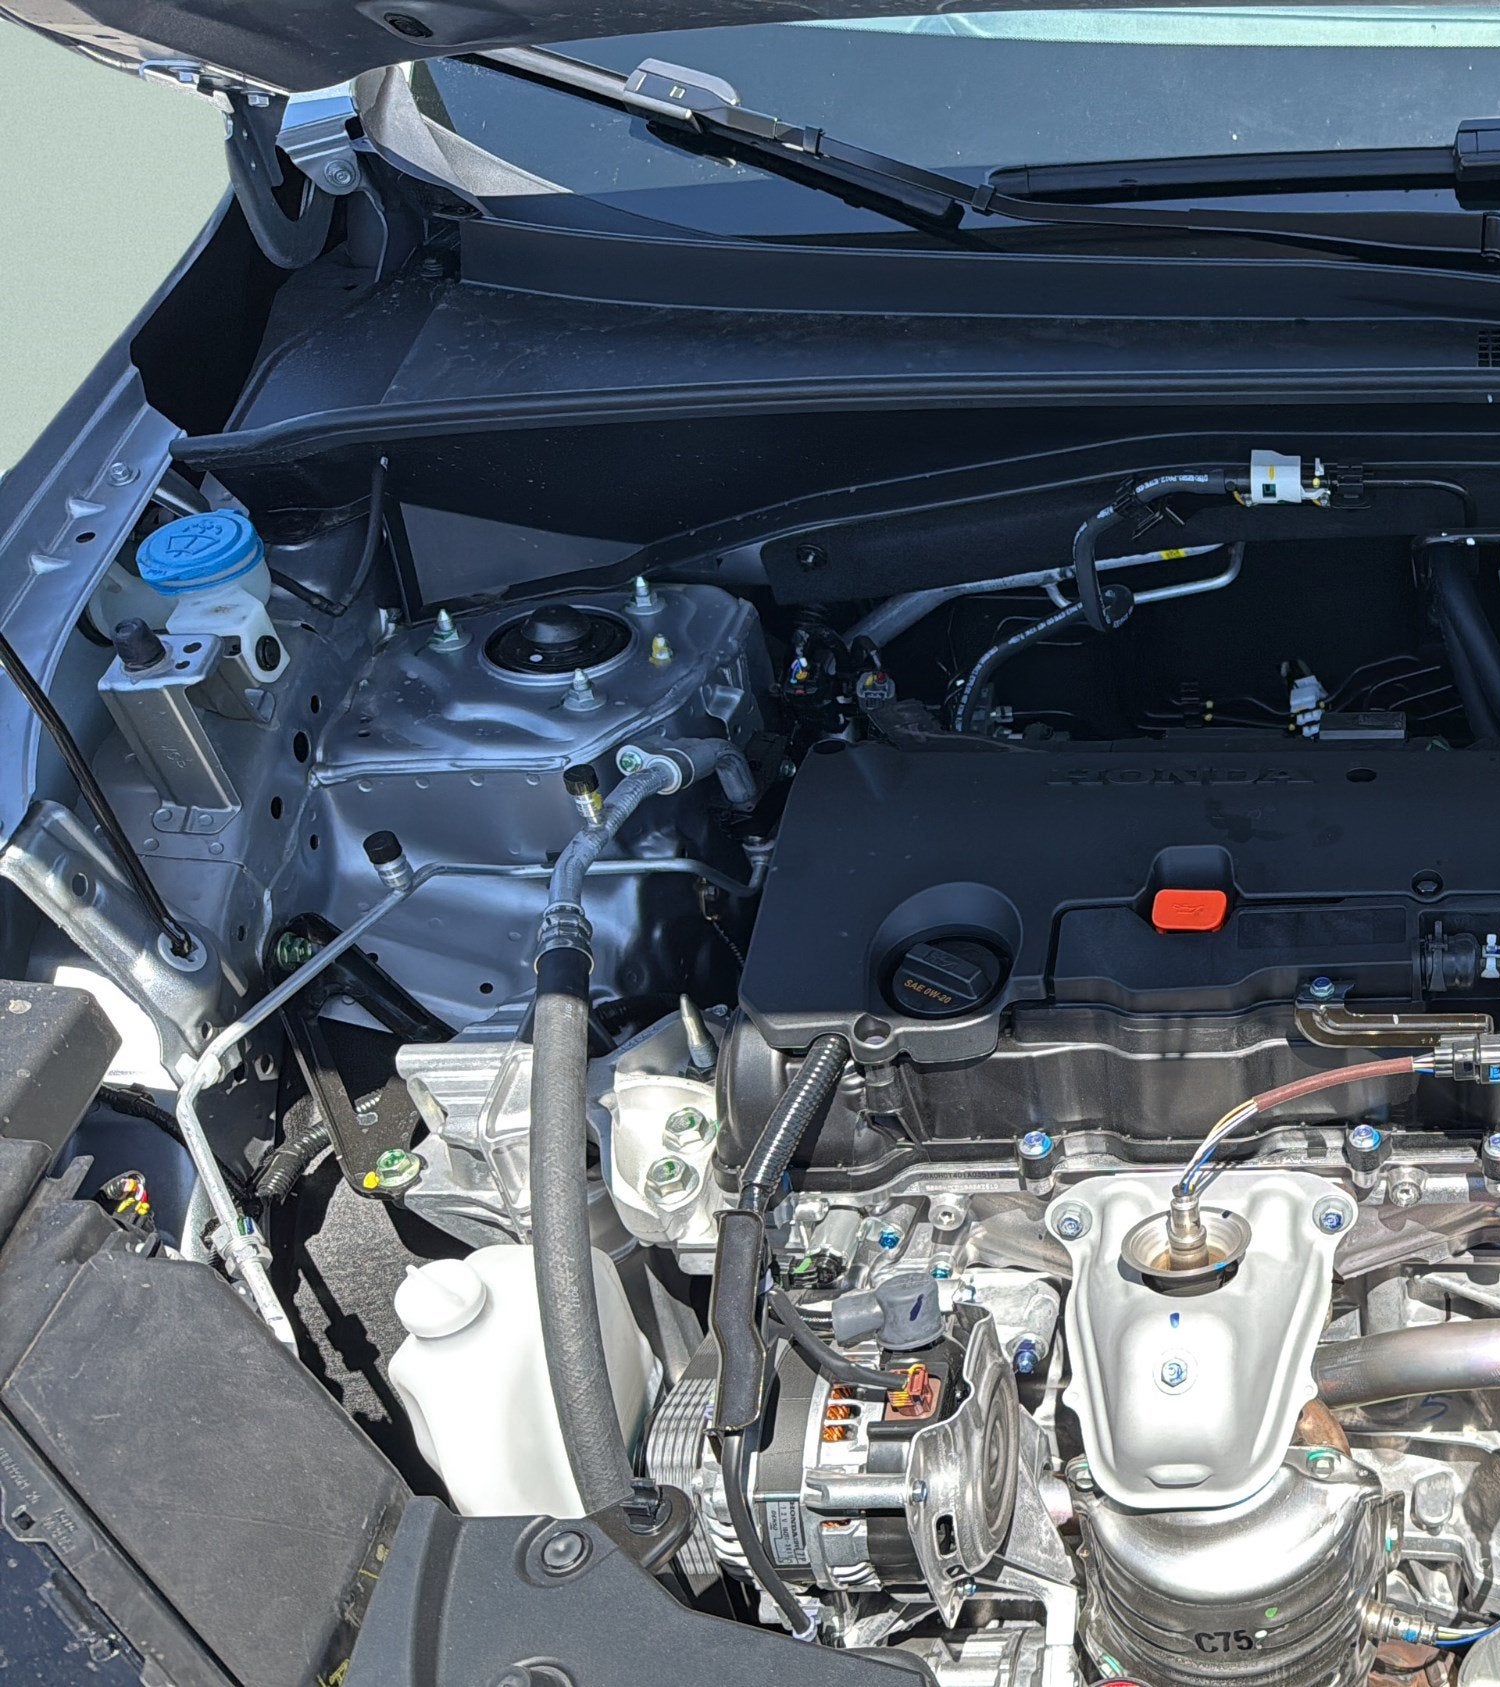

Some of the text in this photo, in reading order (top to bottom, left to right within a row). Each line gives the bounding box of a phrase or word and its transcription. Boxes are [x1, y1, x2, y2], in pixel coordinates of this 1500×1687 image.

[1047, 768, 1316, 785] HONDA
[904, 979, 952, 1004] SAE 0W-20
[1194, 1629, 1254, 1653] C75
